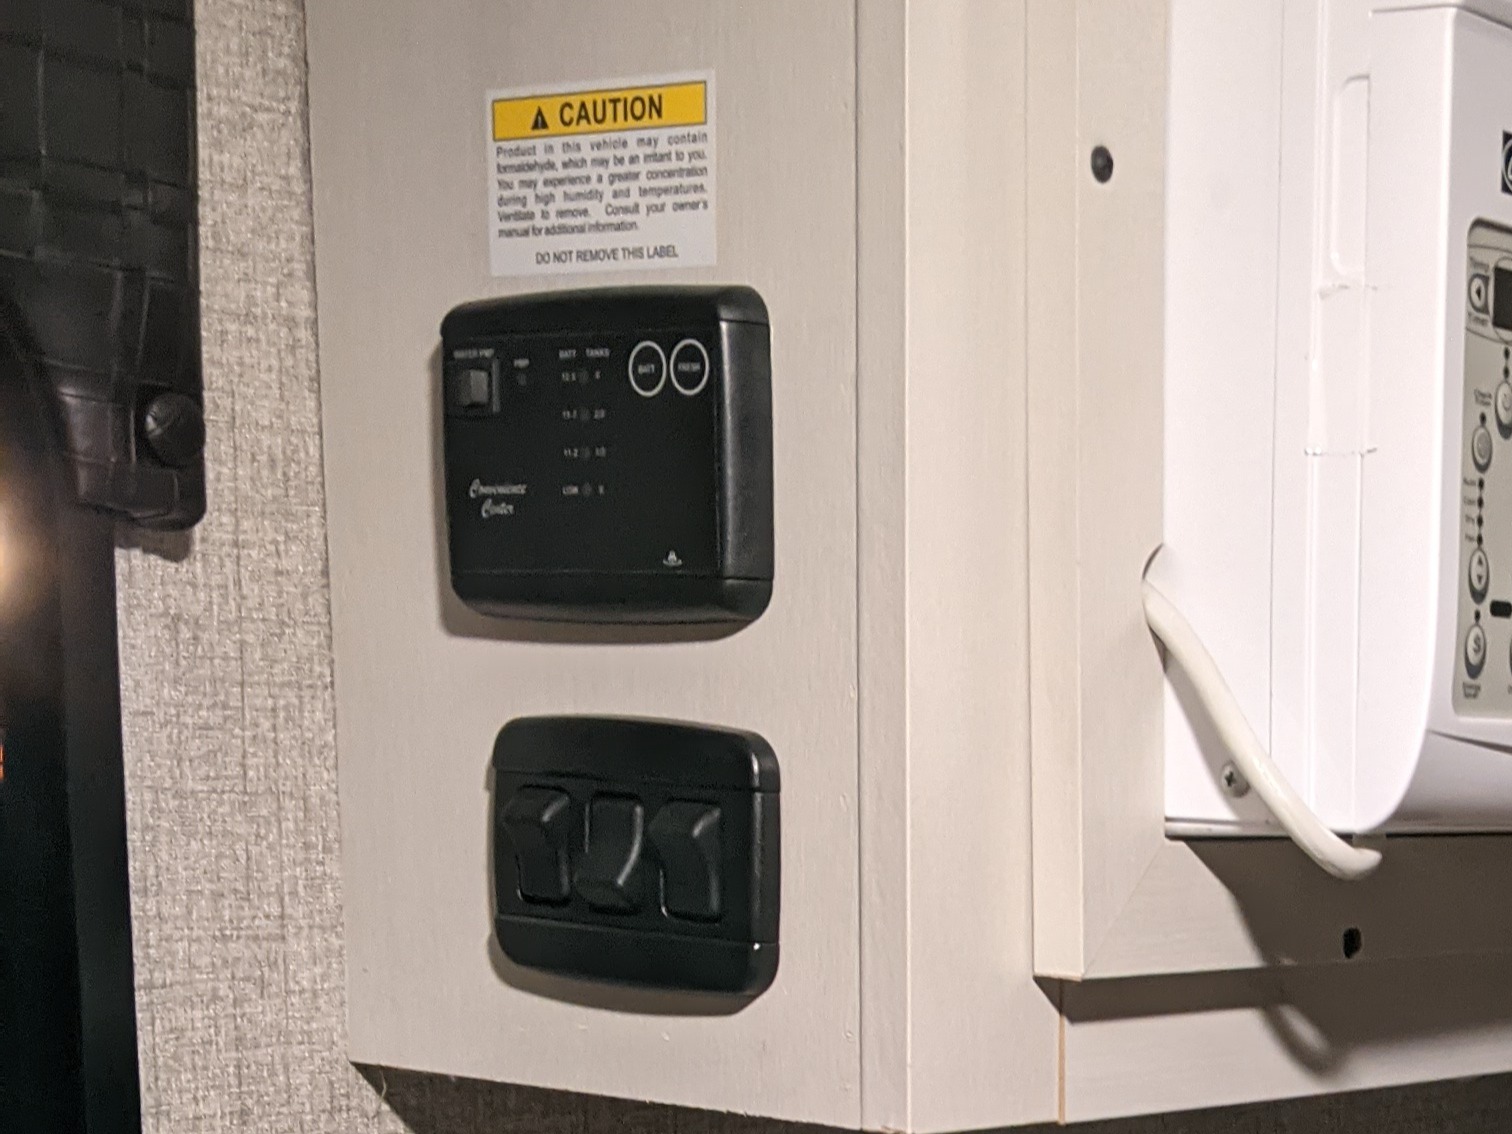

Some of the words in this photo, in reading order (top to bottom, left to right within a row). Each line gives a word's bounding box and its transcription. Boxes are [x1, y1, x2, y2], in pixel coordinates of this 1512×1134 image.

[559, 93, 663, 127] CAUTION
[497, 144, 537, 157] Product
[544, 143, 555, 154] in
[562, 141, 582, 154] this
[590, 137, 628, 151] vehicle
[636, 137, 659, 149] may
[667, 131, 708, 146] contain
[497, 159, 558, 174] formaldehyde,
[561, 157, 587, 169] which
[590, 157, 610, 170] may
[613, 154, 625, 166] be
[628, 153, 640, 165] an
[643, 151, 672, 164] irritant
[675, 150, 685, 162] to
[497, 178, 514, 190] You
[518, 178, 537, 192] may
[543, 175, 592, 190] experience
[597, 174, 603, 184] a
[608, 171, 641, 187] greater
[646, 166, 708, 180] concentration
[498, 194, 527, 209] during
[535, 192, 555, 207] high
[563, 189, 604, 204] humidity
[612, 186, 631, 199] and
[639, 183, 707, 198] temperatures.
[498, 210, 536, 222] Ventilate
[541, 208, 550, 220] to
[605, 202, 640, 216] Consult
[646, 202, 666, 217] your
[672, 200, 709, 212] owner's
[498, 228, 530, 238] manual
[531, 224, 543, 236] for
[544, 223, 586, 236] additional
[535, 250, 551, 265] DO
[553, 249, 574, 263] NOT
[576, 247, 620, 262] REMOVE
[622, 246, 645, 260] THIS
[646, 244, 679, 259] LABEL
